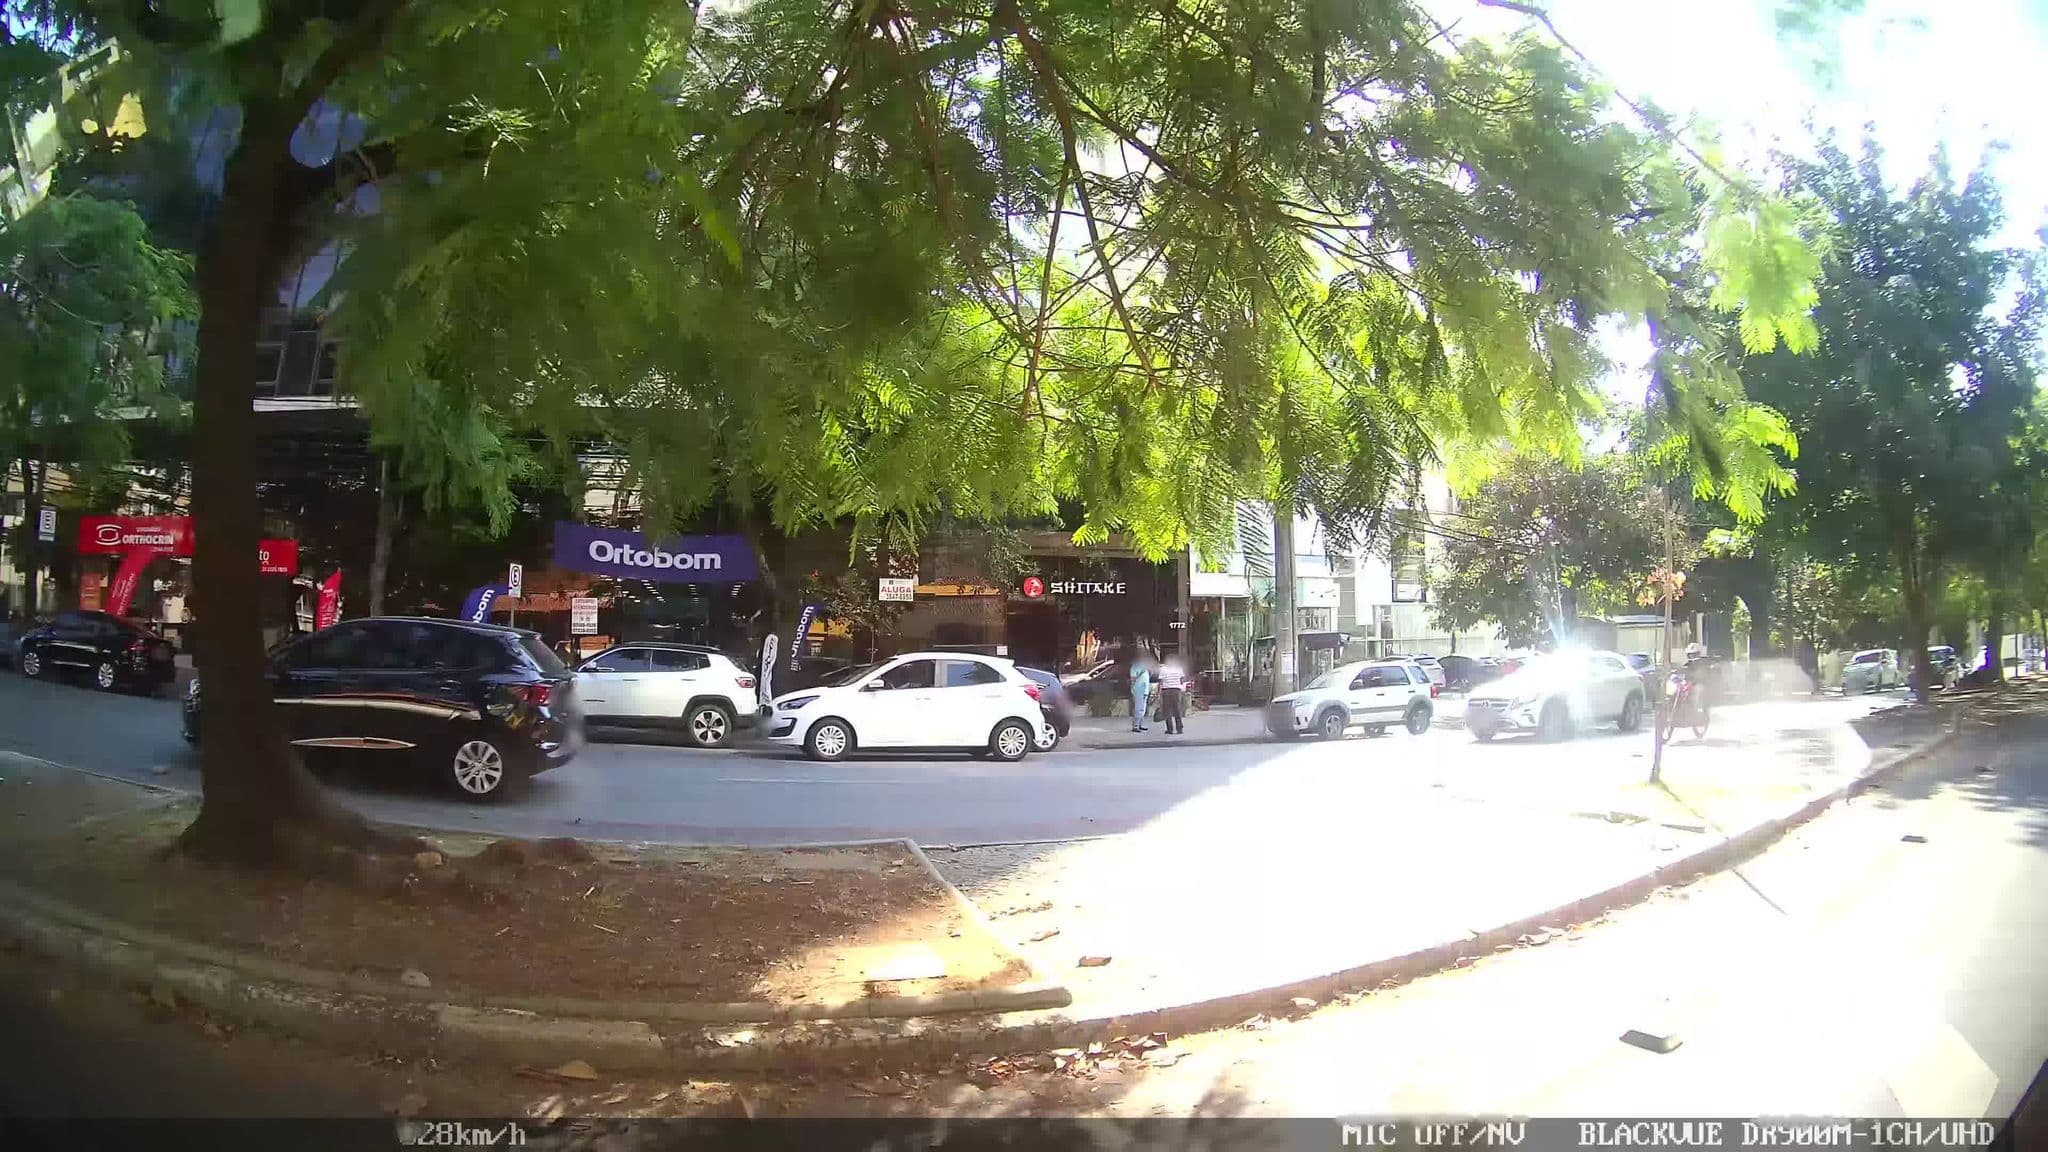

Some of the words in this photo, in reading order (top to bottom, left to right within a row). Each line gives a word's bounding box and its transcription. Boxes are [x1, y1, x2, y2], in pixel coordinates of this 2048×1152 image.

[122, 534, 174, 545] ORTHOCRIN
[589, 540, 722, 570] Ortobom
[1050, 582, 1126, 594] SHITAKE
